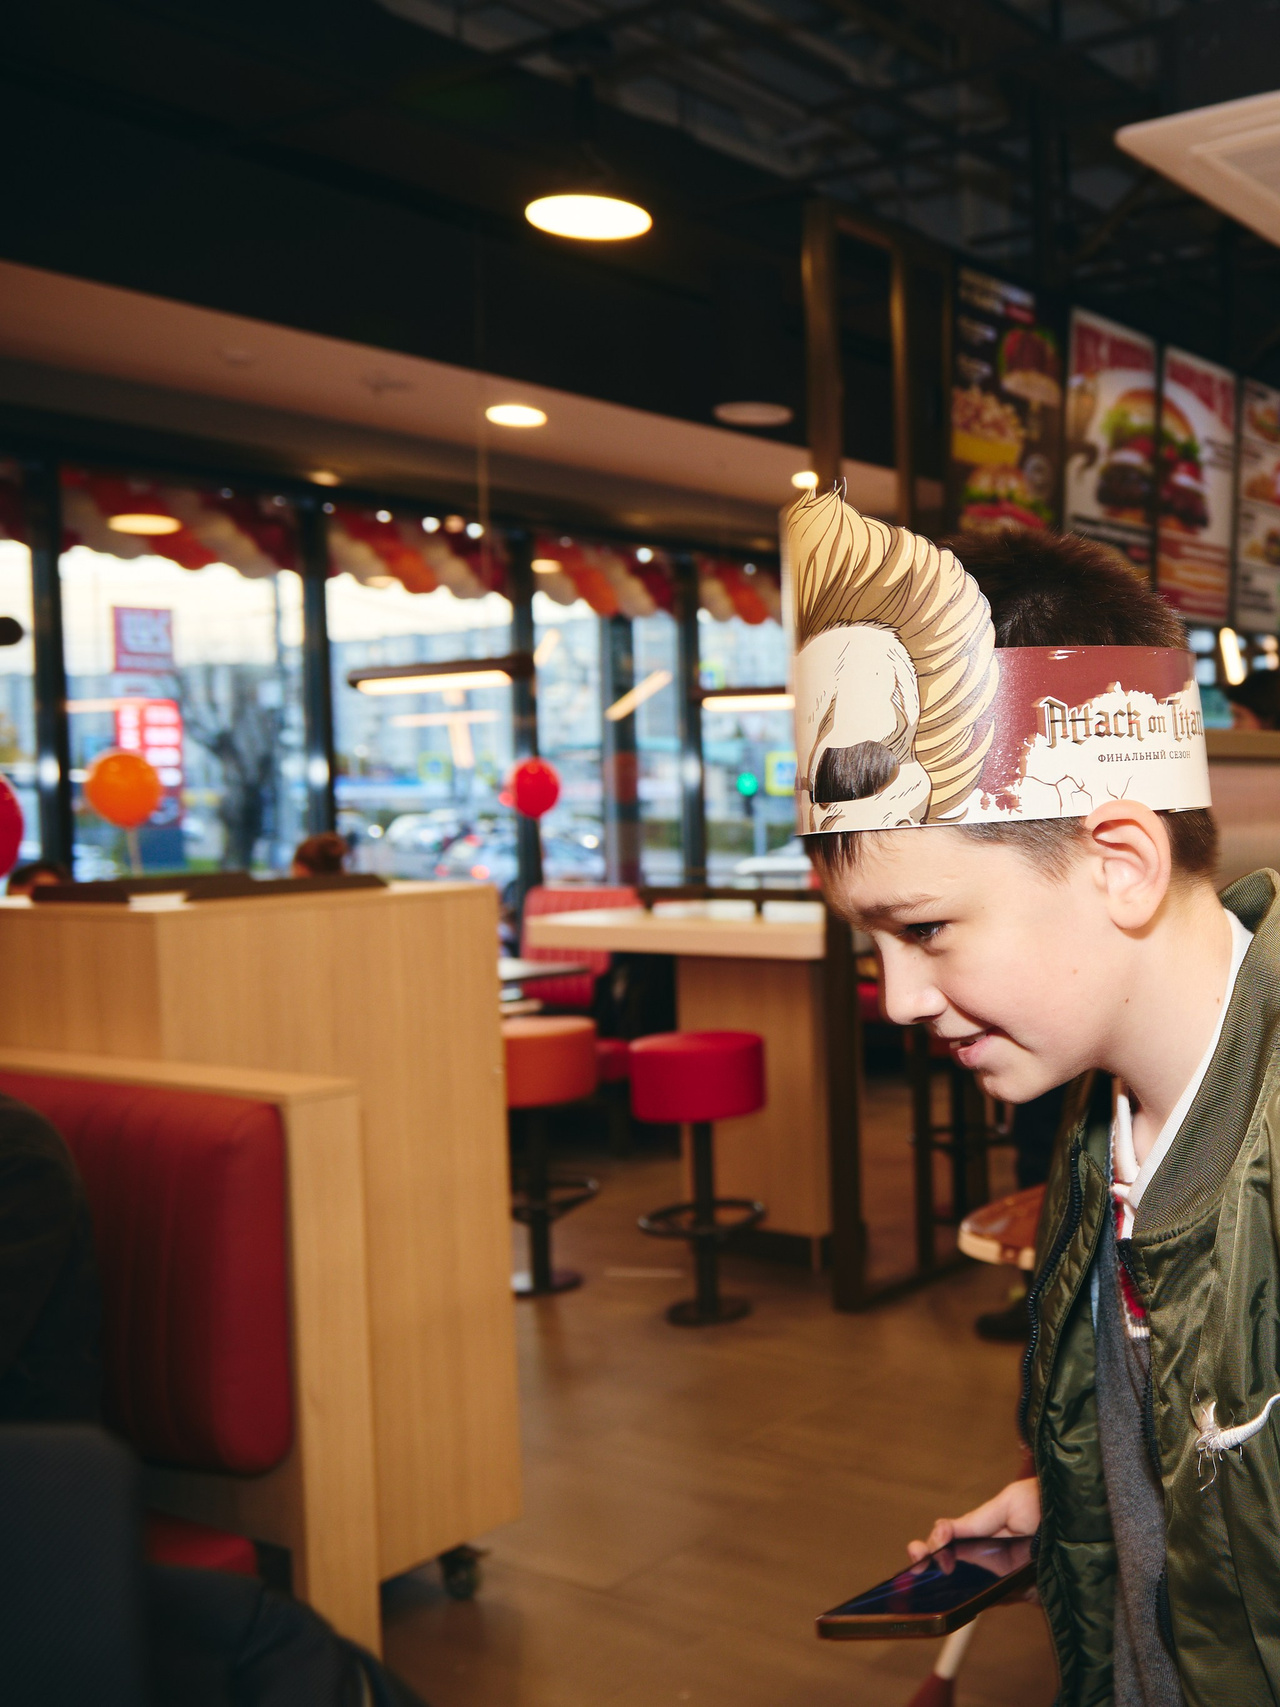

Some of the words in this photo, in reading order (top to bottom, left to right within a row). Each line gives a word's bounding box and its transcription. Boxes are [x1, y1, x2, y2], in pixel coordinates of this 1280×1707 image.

[1042, 697, 1144, 748] Attack
[1148, 715, 1167, 733] on
[1167, 699, 1203, 742] Titan
[1097, 749, 1166, 762] ФИНАЛЬНЫЙ
[1169, 750, 1191, 760] СЕЗОН
